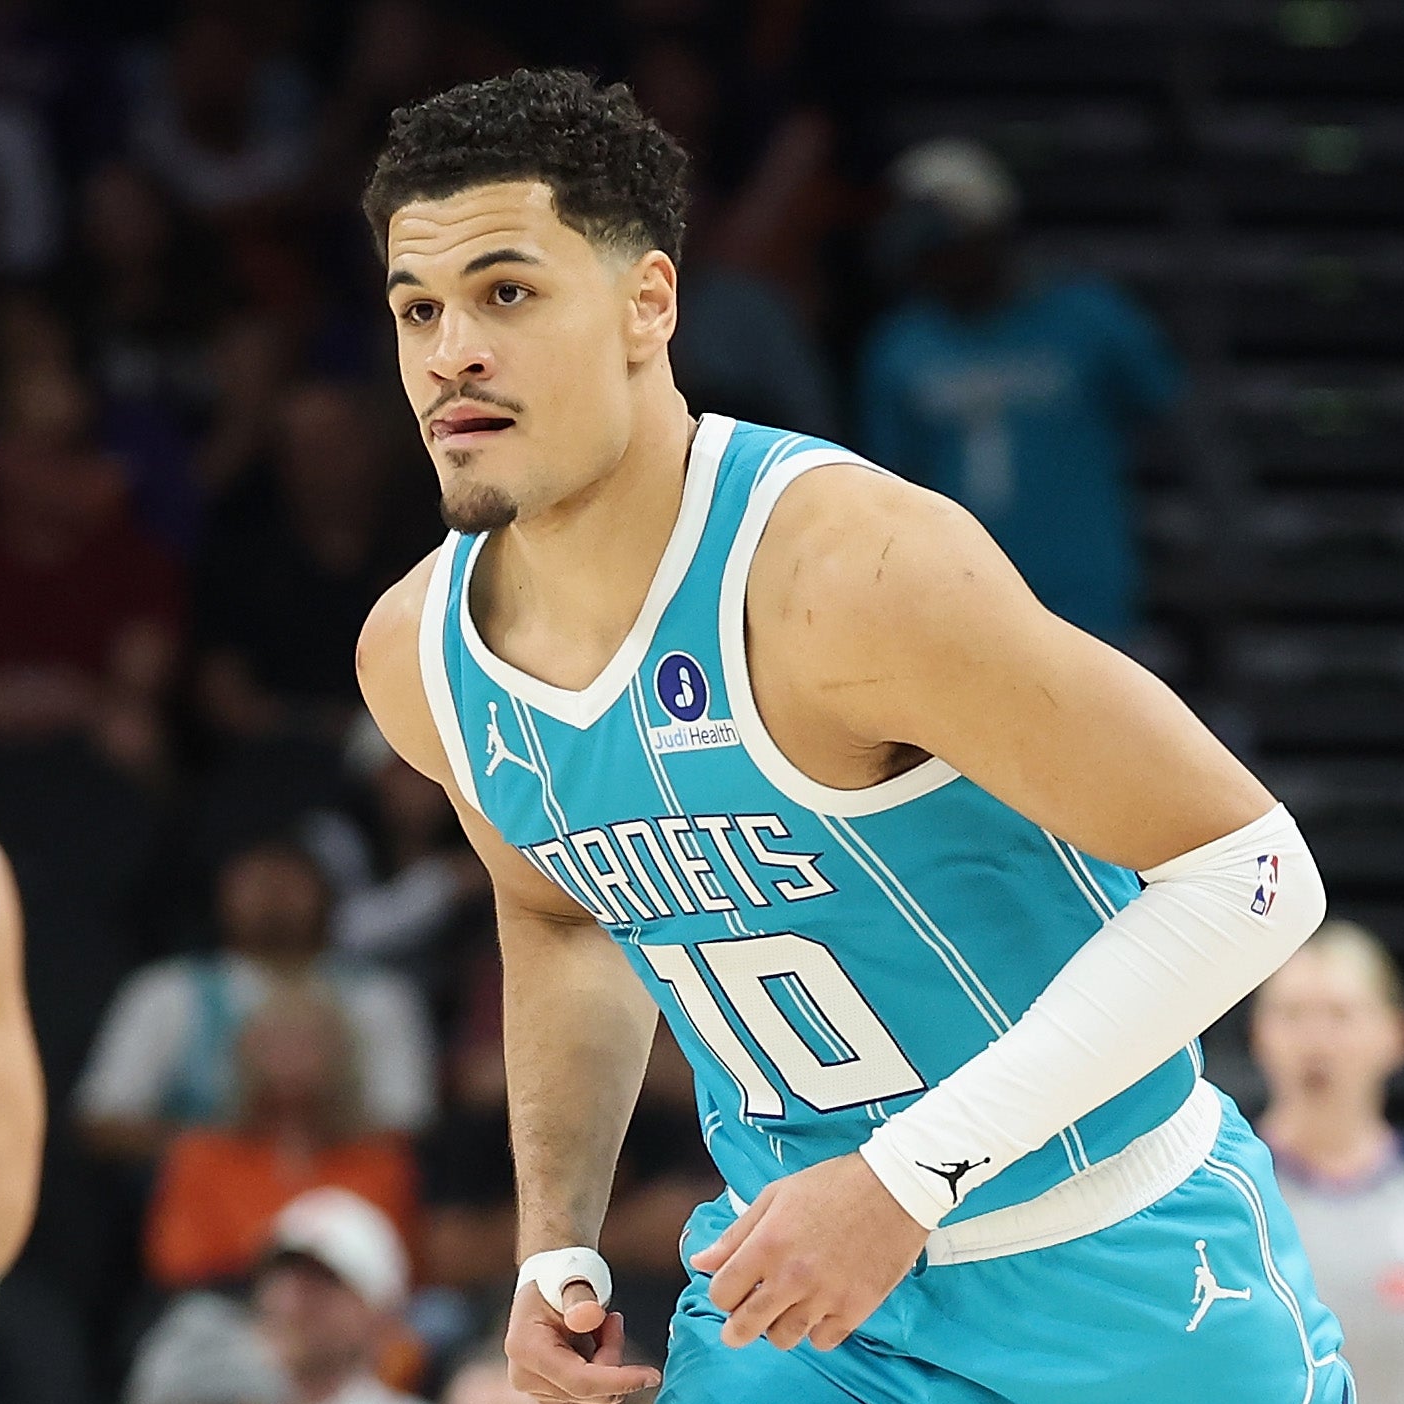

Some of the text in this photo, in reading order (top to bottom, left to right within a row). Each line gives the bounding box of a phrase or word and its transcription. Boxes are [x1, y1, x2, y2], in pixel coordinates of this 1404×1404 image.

[655, 722, 737, 749] Judi Health
[516, 812, 838, 924] ORNETS
[637, 931, 930, 1119] 10
